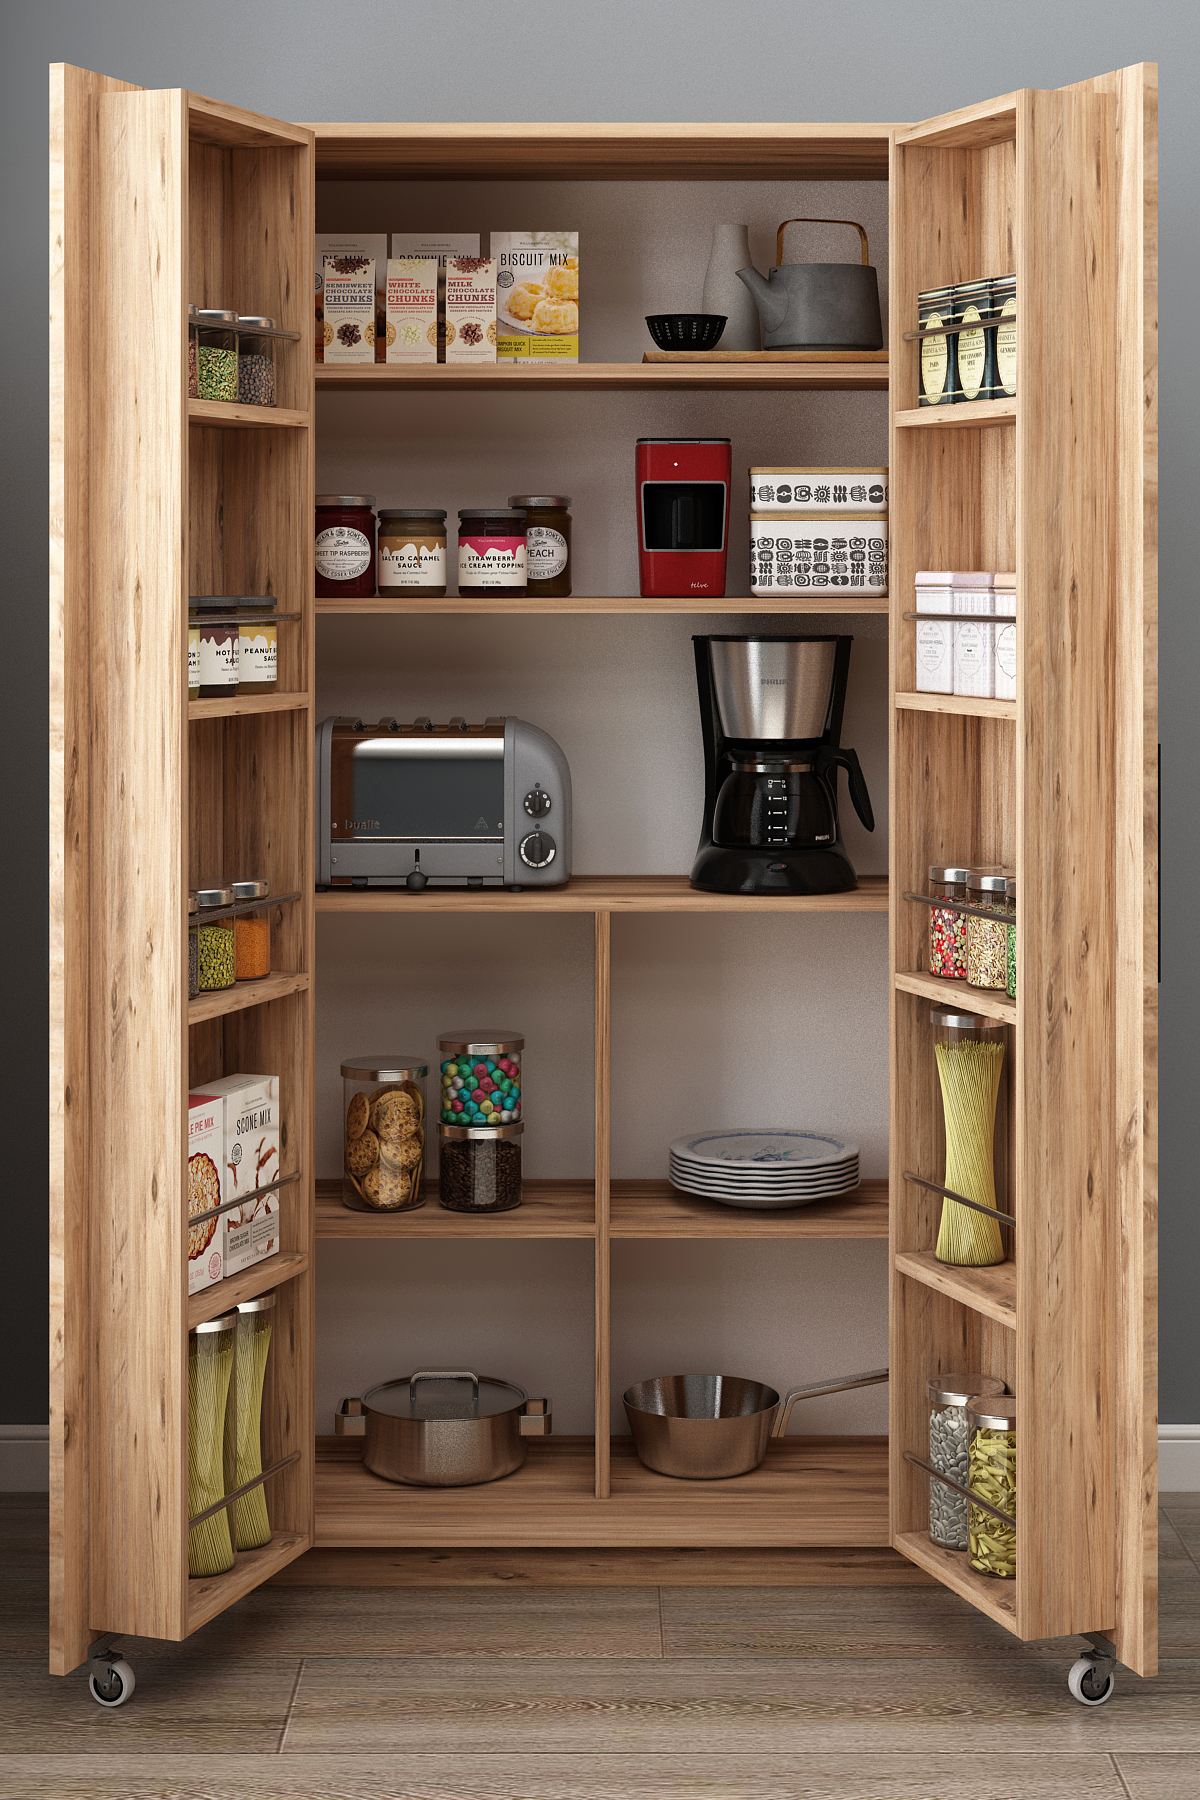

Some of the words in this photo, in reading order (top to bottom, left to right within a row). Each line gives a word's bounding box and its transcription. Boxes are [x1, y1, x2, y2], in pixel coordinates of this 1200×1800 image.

[500, 253, 544, 267] BISCUIT
[549, 253, 569, 267] MIX
[326, 295, 373, 303] CHUNKS
[388, 295, 436, 303] CHUNKS
[448, 294, 495, 302] CHUNKS
[194, 1120, 204, 1134] PIE
[236, 1112, 258, 1136] SCONE
[259, 1108, 272, 1127] MIX
